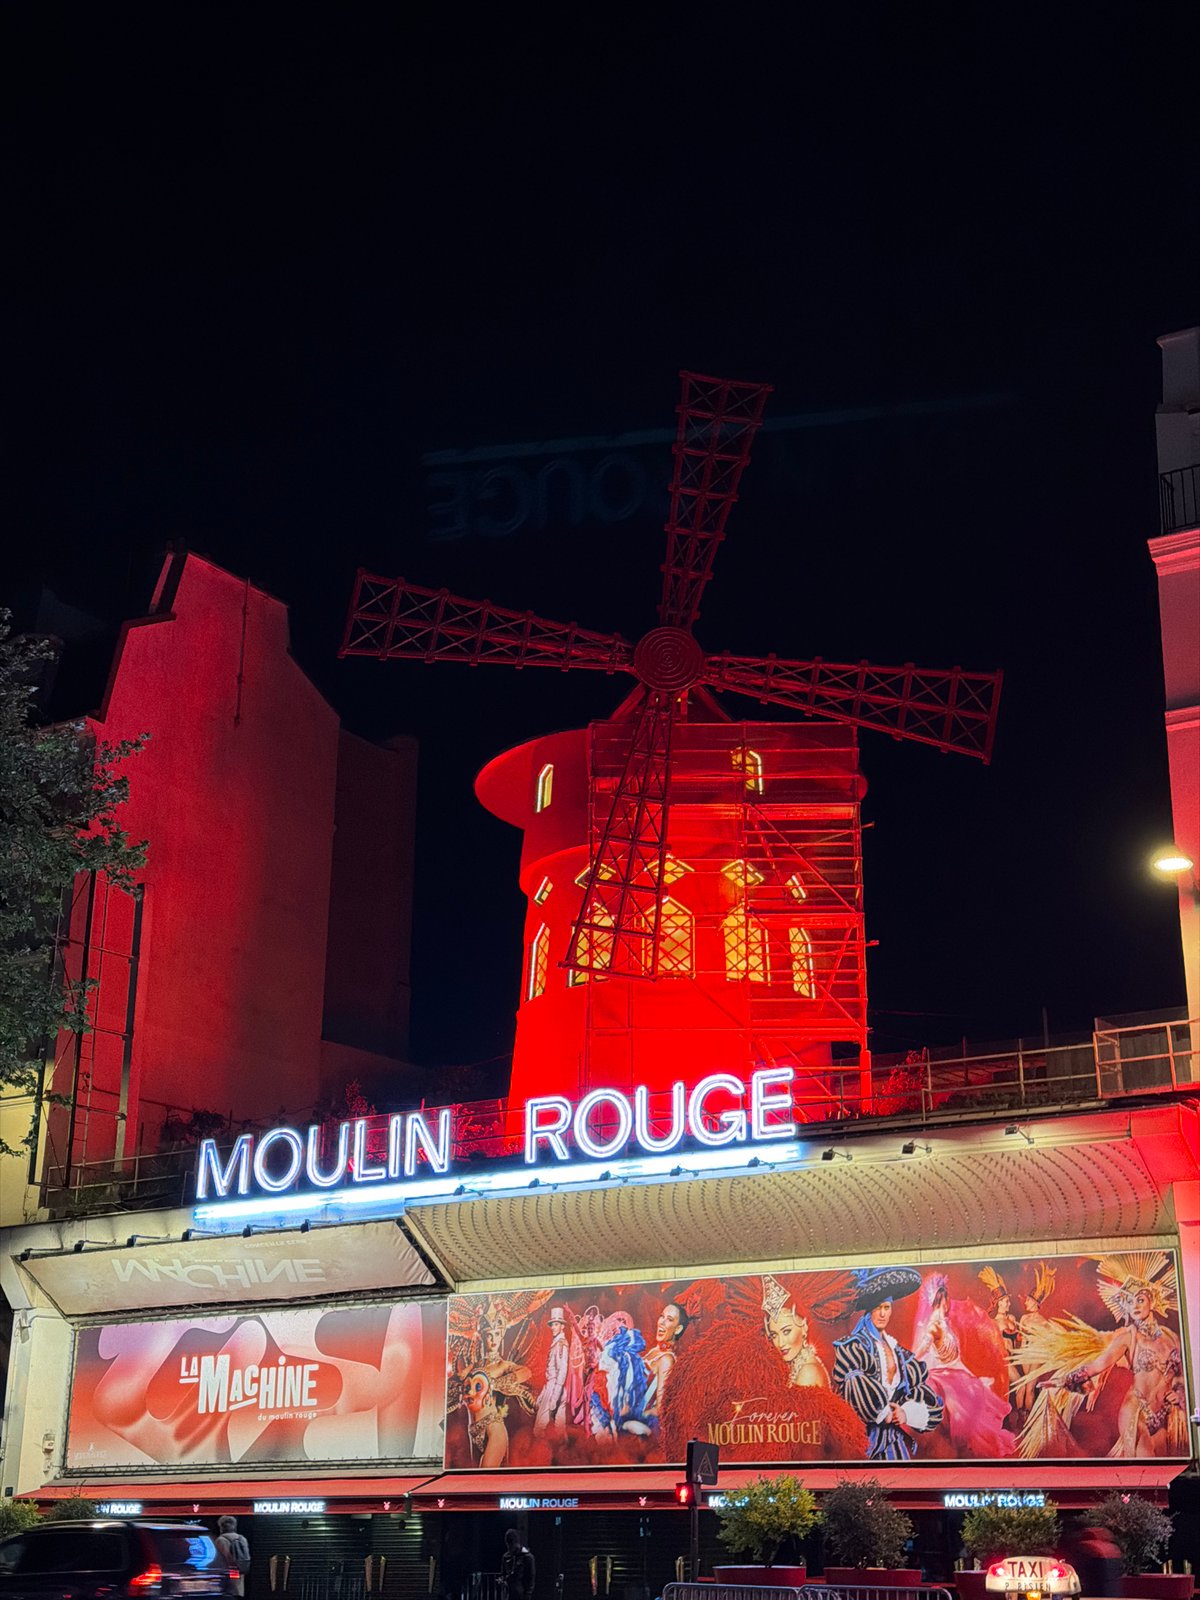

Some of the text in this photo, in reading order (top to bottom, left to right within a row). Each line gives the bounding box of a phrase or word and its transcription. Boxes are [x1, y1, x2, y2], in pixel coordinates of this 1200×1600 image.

[195, 1066, 799, 1200] MOULIN ROUGE
[180, 1356, 199, 1377] LA
[257, 1411, 318, 1421] du moulin rouge
[722, 1397, 799, 1432] Forever
[708, 1420, 822, 1446] MOULIN ROUGE
[110, 1503, 142, 1514] ROUGE
[254, 1502, 326, 1513] MOULIN ROUGE
[500, 1498, 579, 1509] MOULIN ROUGE
[1007, 1561, 1043, 1578] TAXI
